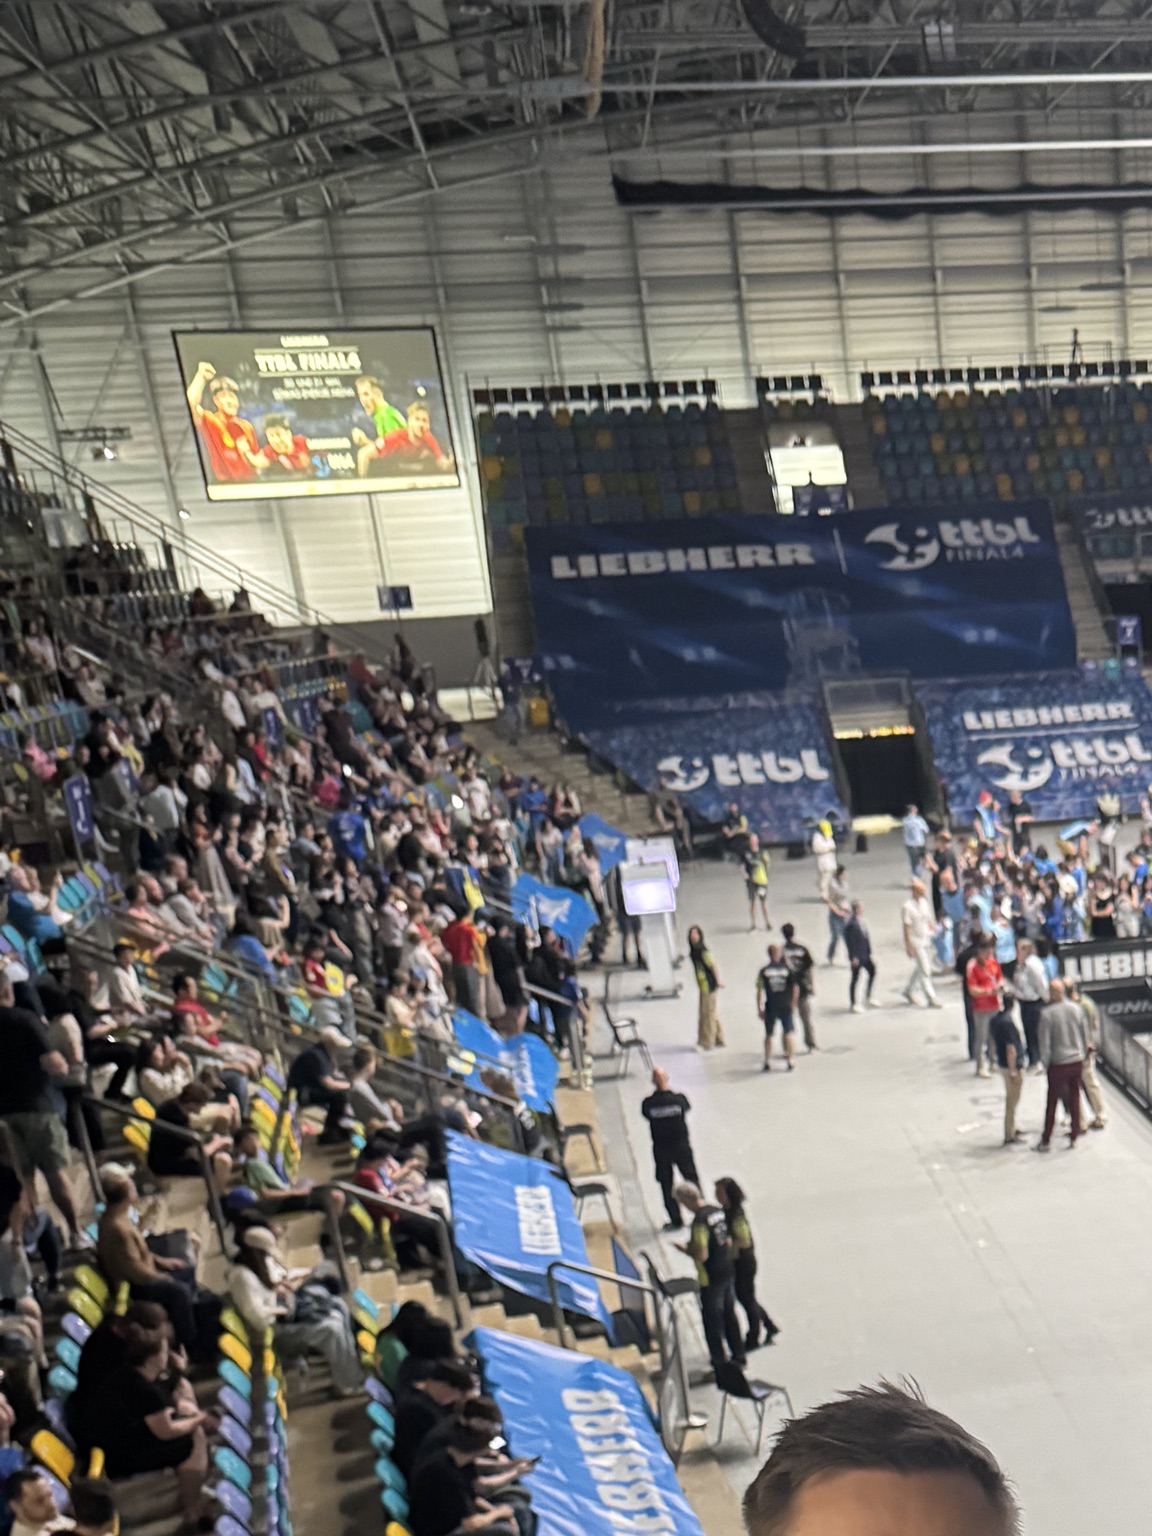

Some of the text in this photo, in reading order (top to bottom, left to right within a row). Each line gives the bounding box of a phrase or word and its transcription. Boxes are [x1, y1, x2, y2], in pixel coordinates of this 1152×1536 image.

[938, 516, 1040, 548] ttbl
[551, 543, 816, 579] LIEBHERR
[963, 701, 1135, 730] LIEBHERR
[711, 750, 830, 786] ttbl
